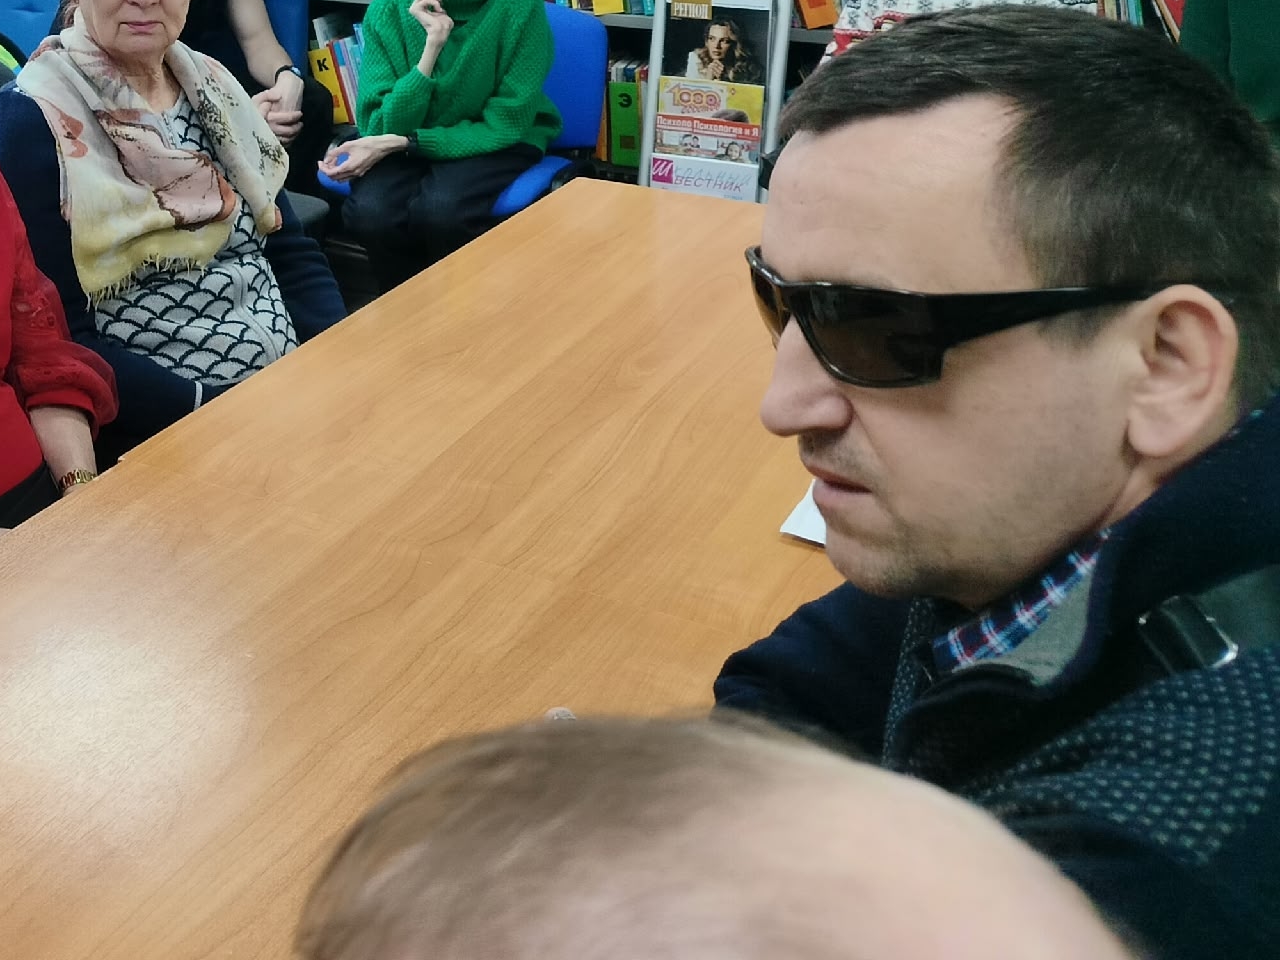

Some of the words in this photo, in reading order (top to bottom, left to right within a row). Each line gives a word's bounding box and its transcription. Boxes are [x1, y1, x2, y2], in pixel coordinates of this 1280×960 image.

[673, 2, 709, 19] РЕГИОН
[316, 57, 329, 73] К
[666, 83, 721, 107] 1000
[694, 121, 743, 135] Психология
[752, 128, 759, 137] Я
[674, 176, 744, 193] ВЕСТНИК
